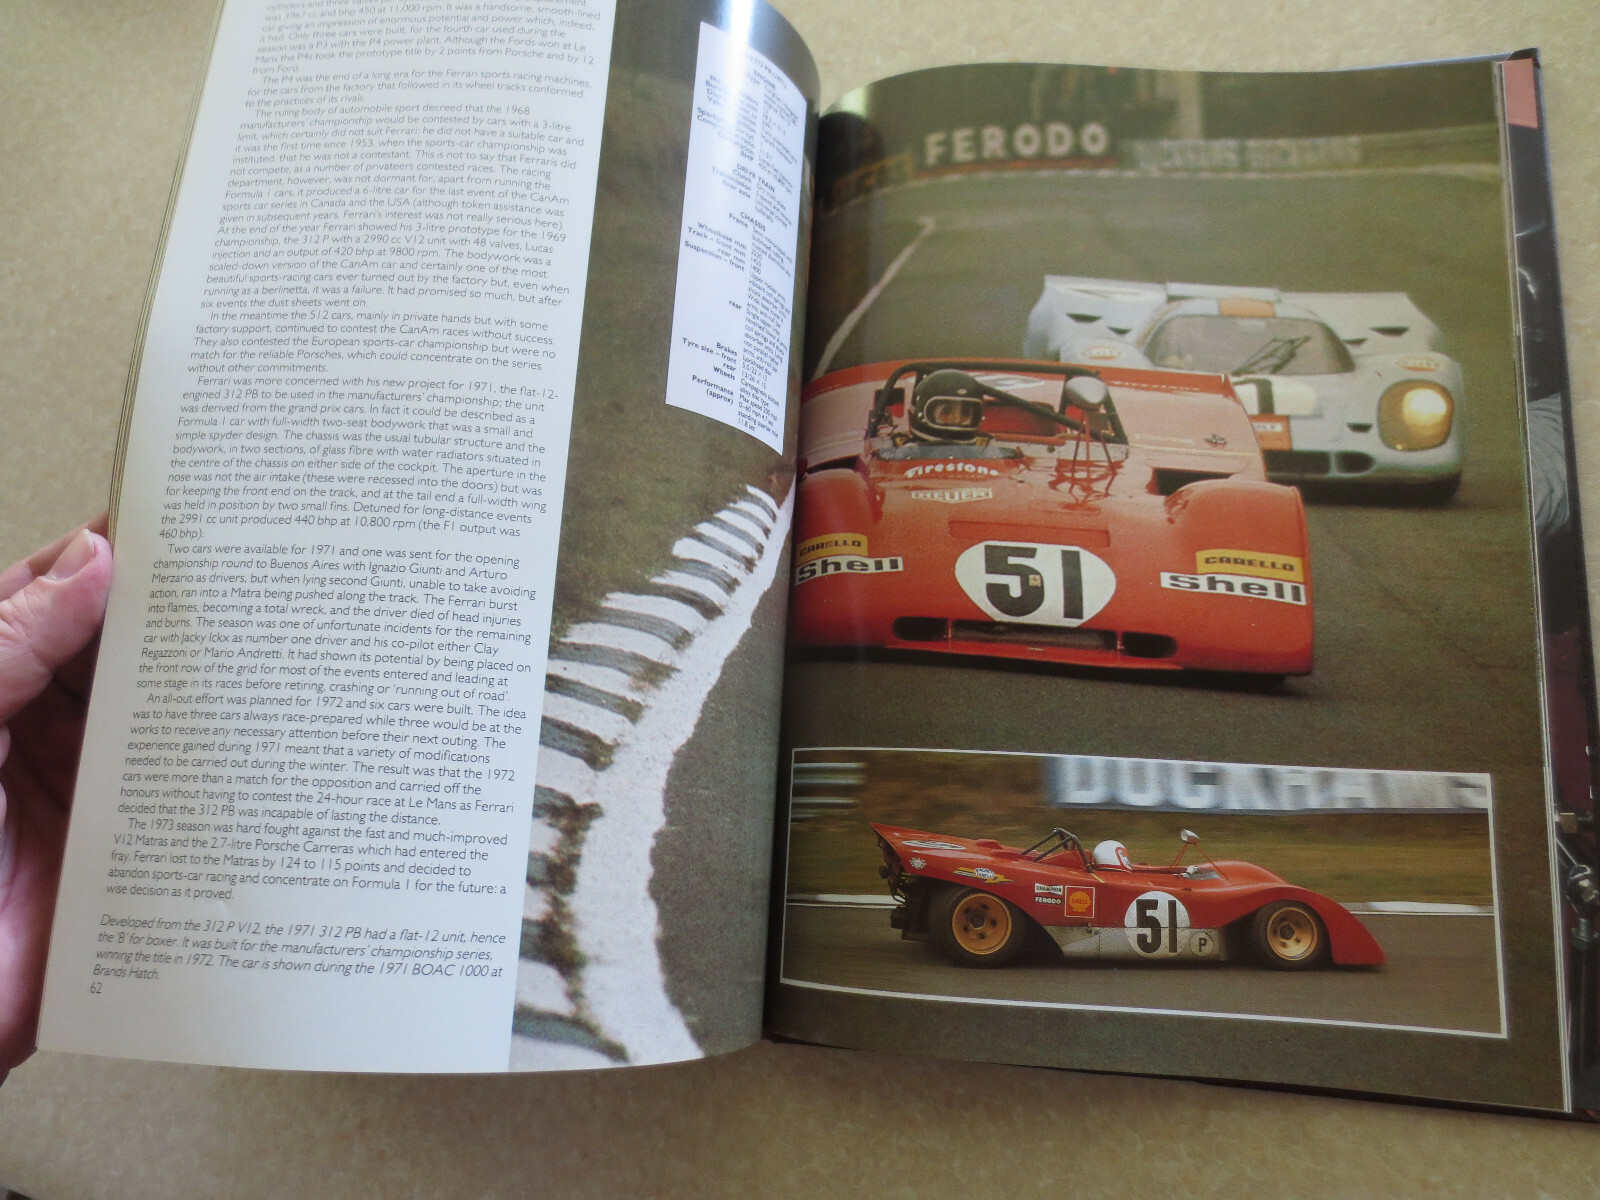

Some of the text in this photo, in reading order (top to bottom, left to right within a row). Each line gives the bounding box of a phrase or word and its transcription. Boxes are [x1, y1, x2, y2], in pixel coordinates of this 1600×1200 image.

[254, 108, 273, 118] The
[273, 107, 301, 120] ruling
[301, 106, 326, 119] body
[338, 103, 393, 114] automobile
[394, 104, 420, 116] sport
[422, 103, 463, 112] decreed
[464, 103, 484, 113] that
[486, 104, 503, 113] the
[506, 105, 530, 115] 1968
[925, 122, 1109, 166] FERODO
[729, 213, 748, 228] Frame
[740, 212, 766, 231] CHASSIS
[688, 227, 708, 239] Track
[698, 222, 732, 242] Wheelbase
[283, 233, 300, 245] the
[301, 234, 320, 245] 312
[331, 233, 353, 244] with
[363, 233, 390, 244] 2990
[404, 234, 425, 244] V12
[427, 235, 447, 245] unit
[448, 234, 471, 247] with
[525, 241, 554, 254] Lucas
[685, 240, 744, 272] Suspension front
[729, 301, 741, 309] rear
[682, 337, 737, 364] Tyre size front
[716, 342, 737, 356] Brakes
[713, 366, 735, 380] Wheels
[723, 363, 736, 372] rear
[197, 375, 559, 398] Ferrari was more concerned with his new project for 1971, the flat-12-
[692, 375, 734, 396] Performance
[706, 388, 734, 405] (approx)
[167, 543, 520, 568] Two cars were available for 1971 and one was sent for the opening
[1204, 556, 1295, 572] CARELLO
[984, 545, 1084, 618] 51
[129, 818, 508, 846] The 1973 season was hard fought against the fast and much-improved
[1035, 896, 1062, 904] FERODO
[100, 915, 156, 930] Developed
[156, 917, 182, 930] from
[183, 919, 202, 930] the
[203, 919, 225, 931] 312
[226, 920, 236, 932] P
[238, 921, 261, 935] V12,
[264, 922, 284, 934] the
[287, 924, 315, 936] 1971
[318, 925, 343, 937] 312
[344, 926, 362, 938] PB
[363, 927, 388, 938] had
[399, 928, 440, 940] flat-12
[441, 930, 467, 943] unit,
[470, 931, 507, 943] hence
[1136, 899, 1178, 954] 51
[98, 931, 115, 943] the
[128, 933, 146, 945] for
[181, 936, 190, 947] It
[192, 940, 213, 948] was
[213, 937, 239, 950] built
[239, 939, 259, 951] for
[259, 940, 279, 952] the
[370, 945, 454, 961] championship
[1198, 938, 1207, 952] P
[92, 964, 160, 980] Brands Hatch.
[96, 950, 504, 978] winning the title in 1972. The car is shown during the 1971 BOAC 1000 at
[88, 981, 103, 994] 62
